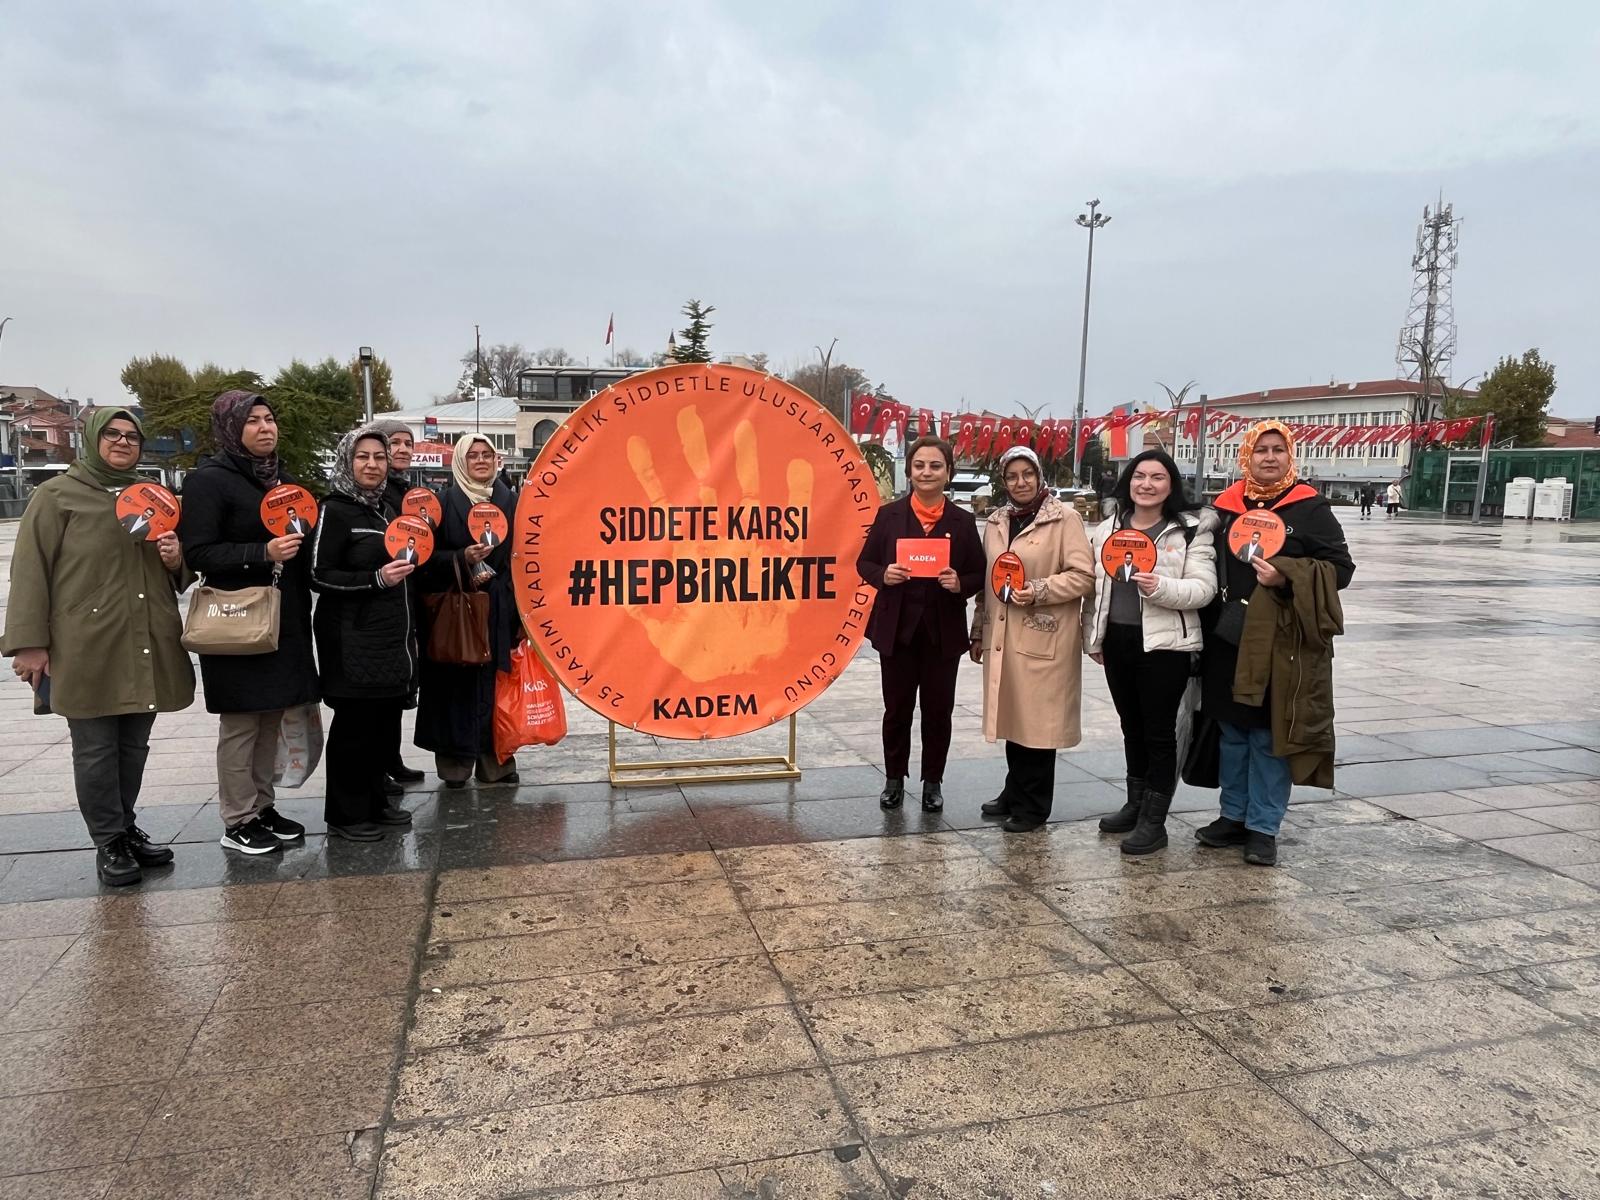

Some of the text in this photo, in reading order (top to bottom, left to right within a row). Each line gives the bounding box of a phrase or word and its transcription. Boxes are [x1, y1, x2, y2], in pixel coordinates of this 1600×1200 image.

[524, 375, 874, 708] 25 KASIM KADINA YÖNELİK ŞİDDETLE ULUSLARARASI MADELE GÜNÜ
[599, 506, 808, 545] ŞİDDETE KARŞI
[567, 556, 837, 606] #HEPBİRLİKTE
[653, 694, 758, 721] KADEM
